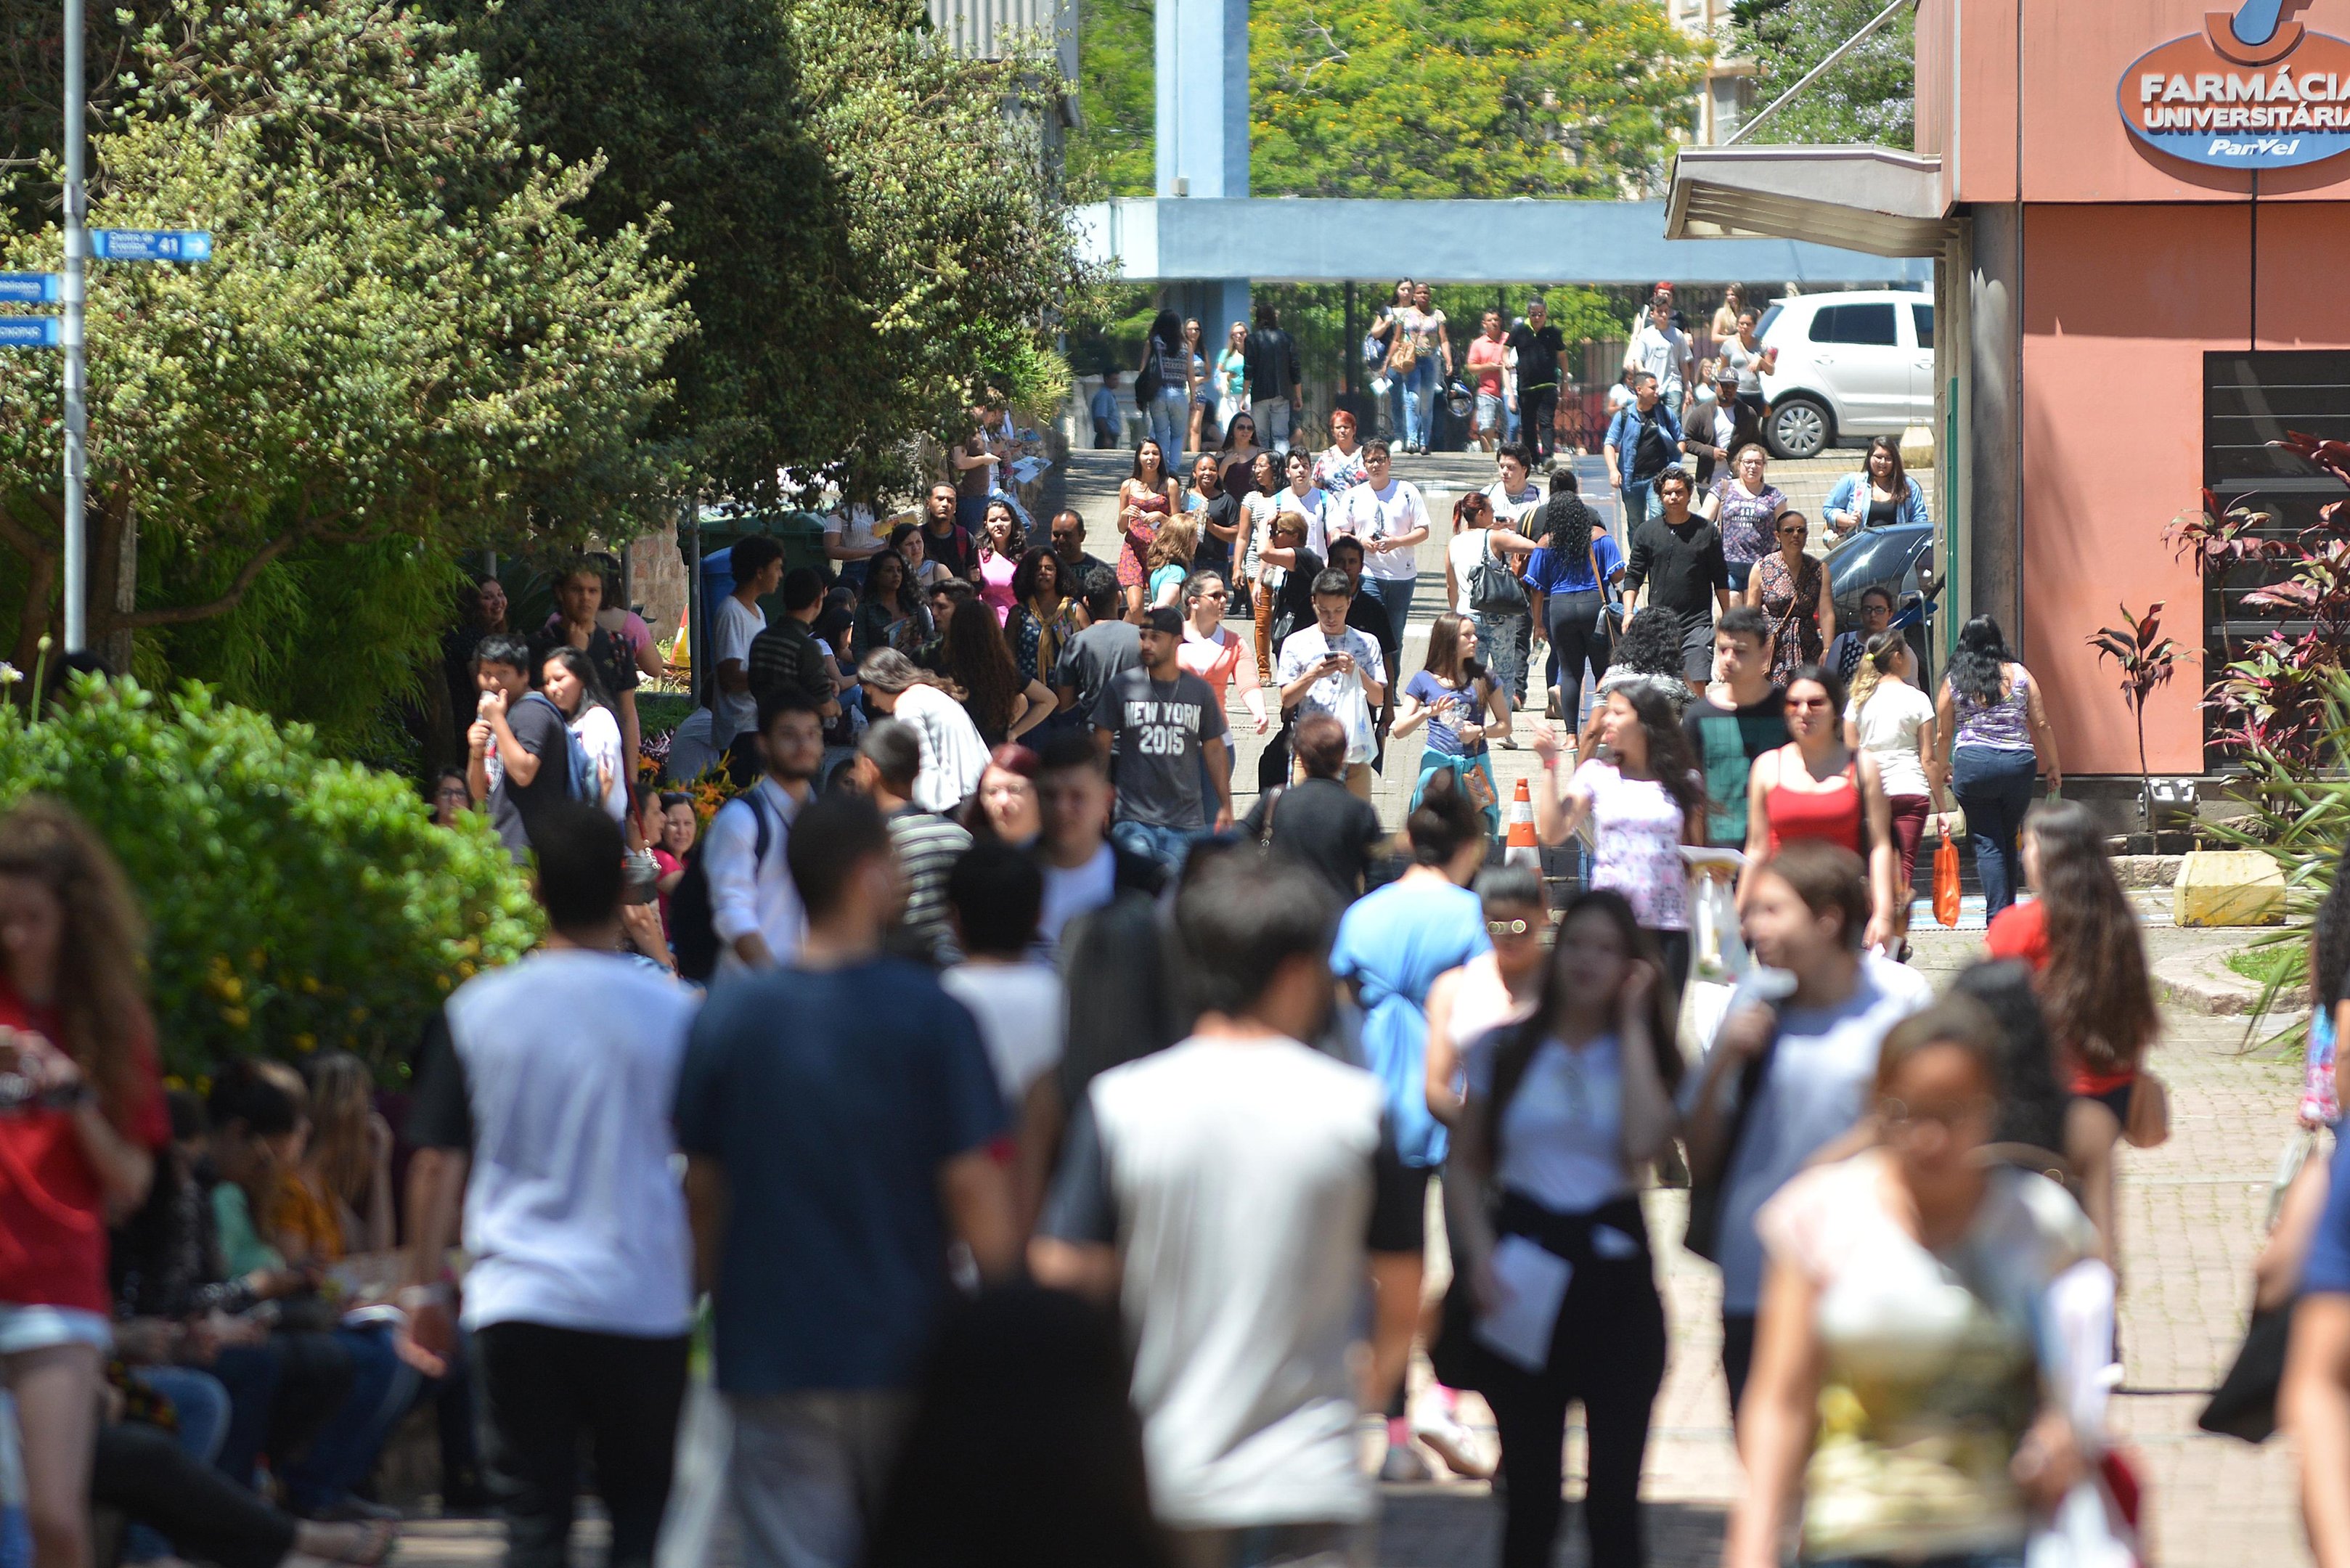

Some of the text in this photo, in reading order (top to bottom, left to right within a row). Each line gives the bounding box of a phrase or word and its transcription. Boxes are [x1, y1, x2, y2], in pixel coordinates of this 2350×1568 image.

[158, 237, 179, 255] 41
[1125, 701, 1201, 733] NEW YORK
[1138, 724, 1186, 756] 2015
